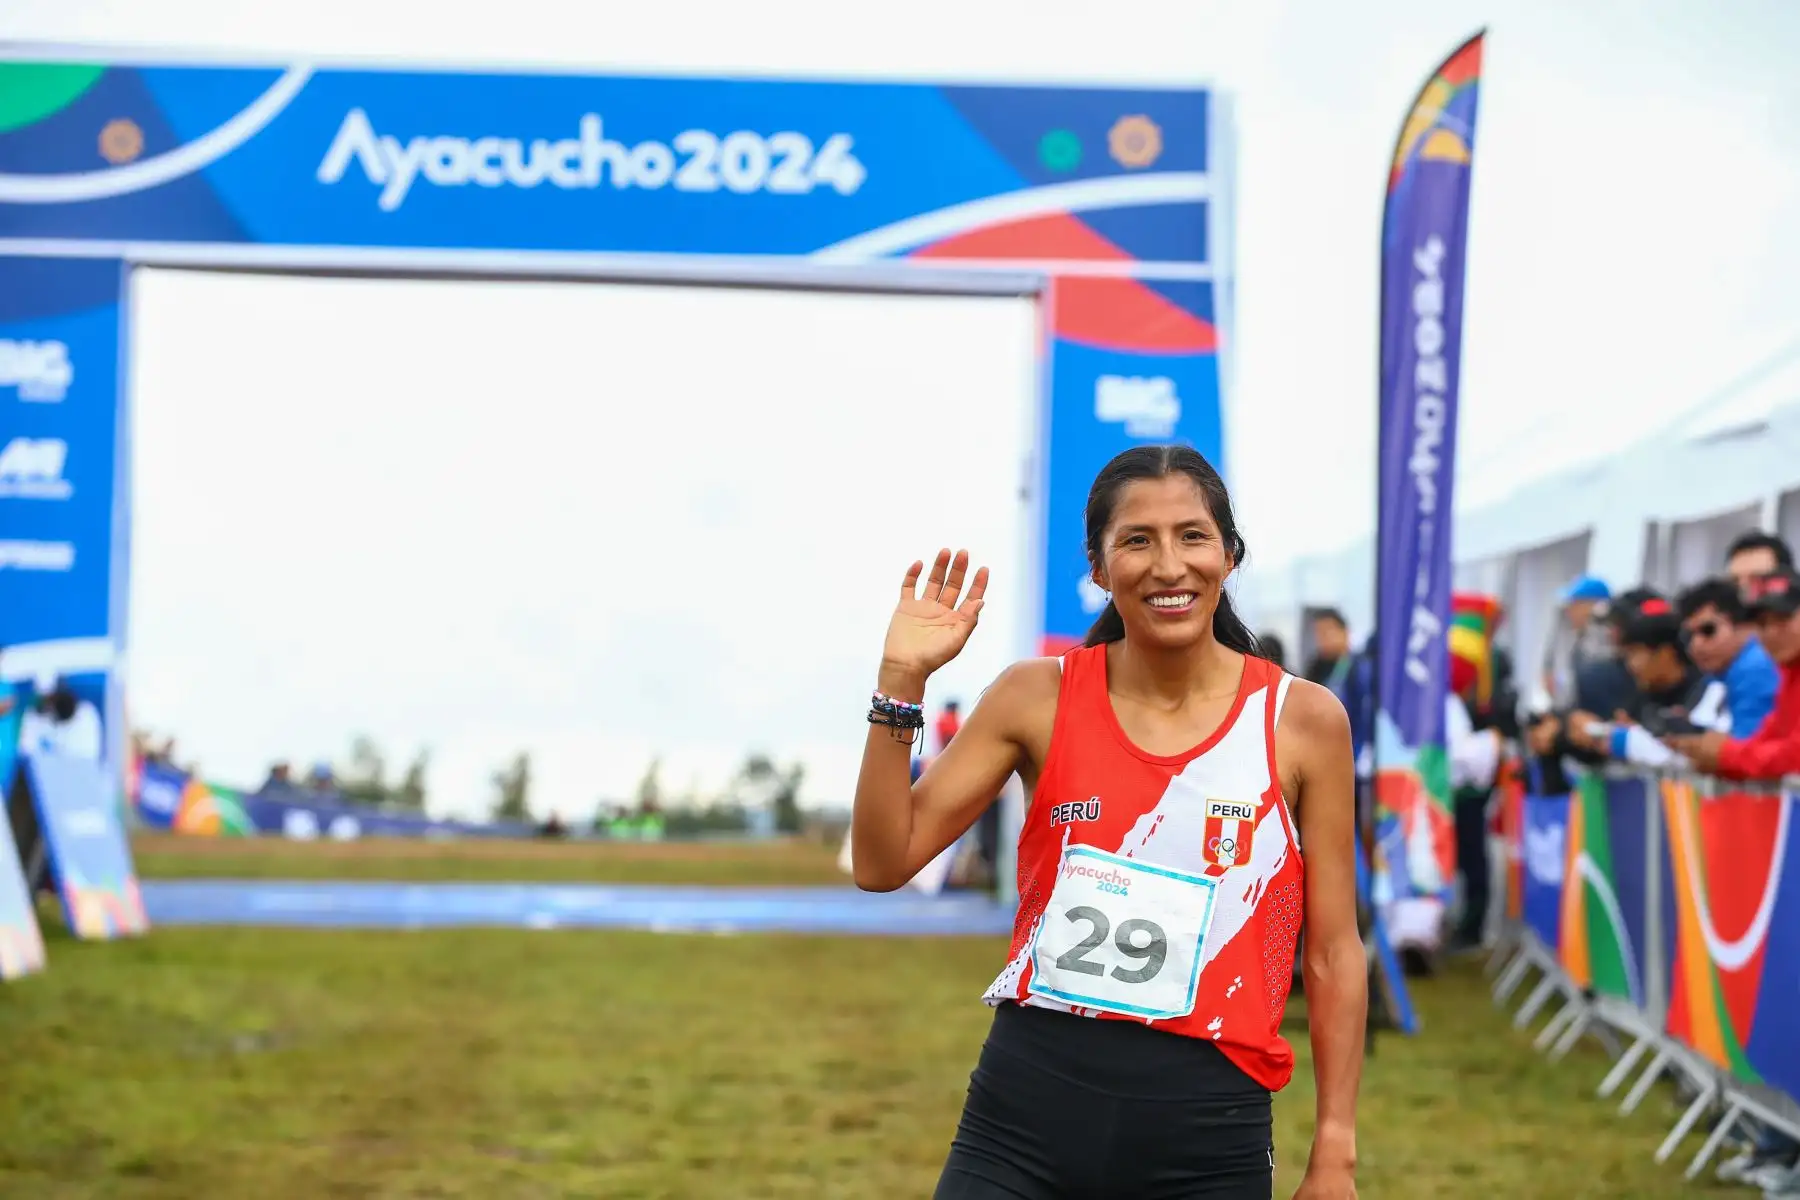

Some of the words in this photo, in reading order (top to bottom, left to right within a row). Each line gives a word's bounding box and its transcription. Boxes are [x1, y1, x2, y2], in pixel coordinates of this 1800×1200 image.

[317, 107, 867, 212] Ayacucho2024
[1405, 233, 1446, 686] Aycho2024
[1051, 797, 1101, 827] PERÚ
[1211, 804, 1252, 819] PERÚ
[1096, 880, 1129, 897] 2024
[1055, 905, 1168, 984] 29
